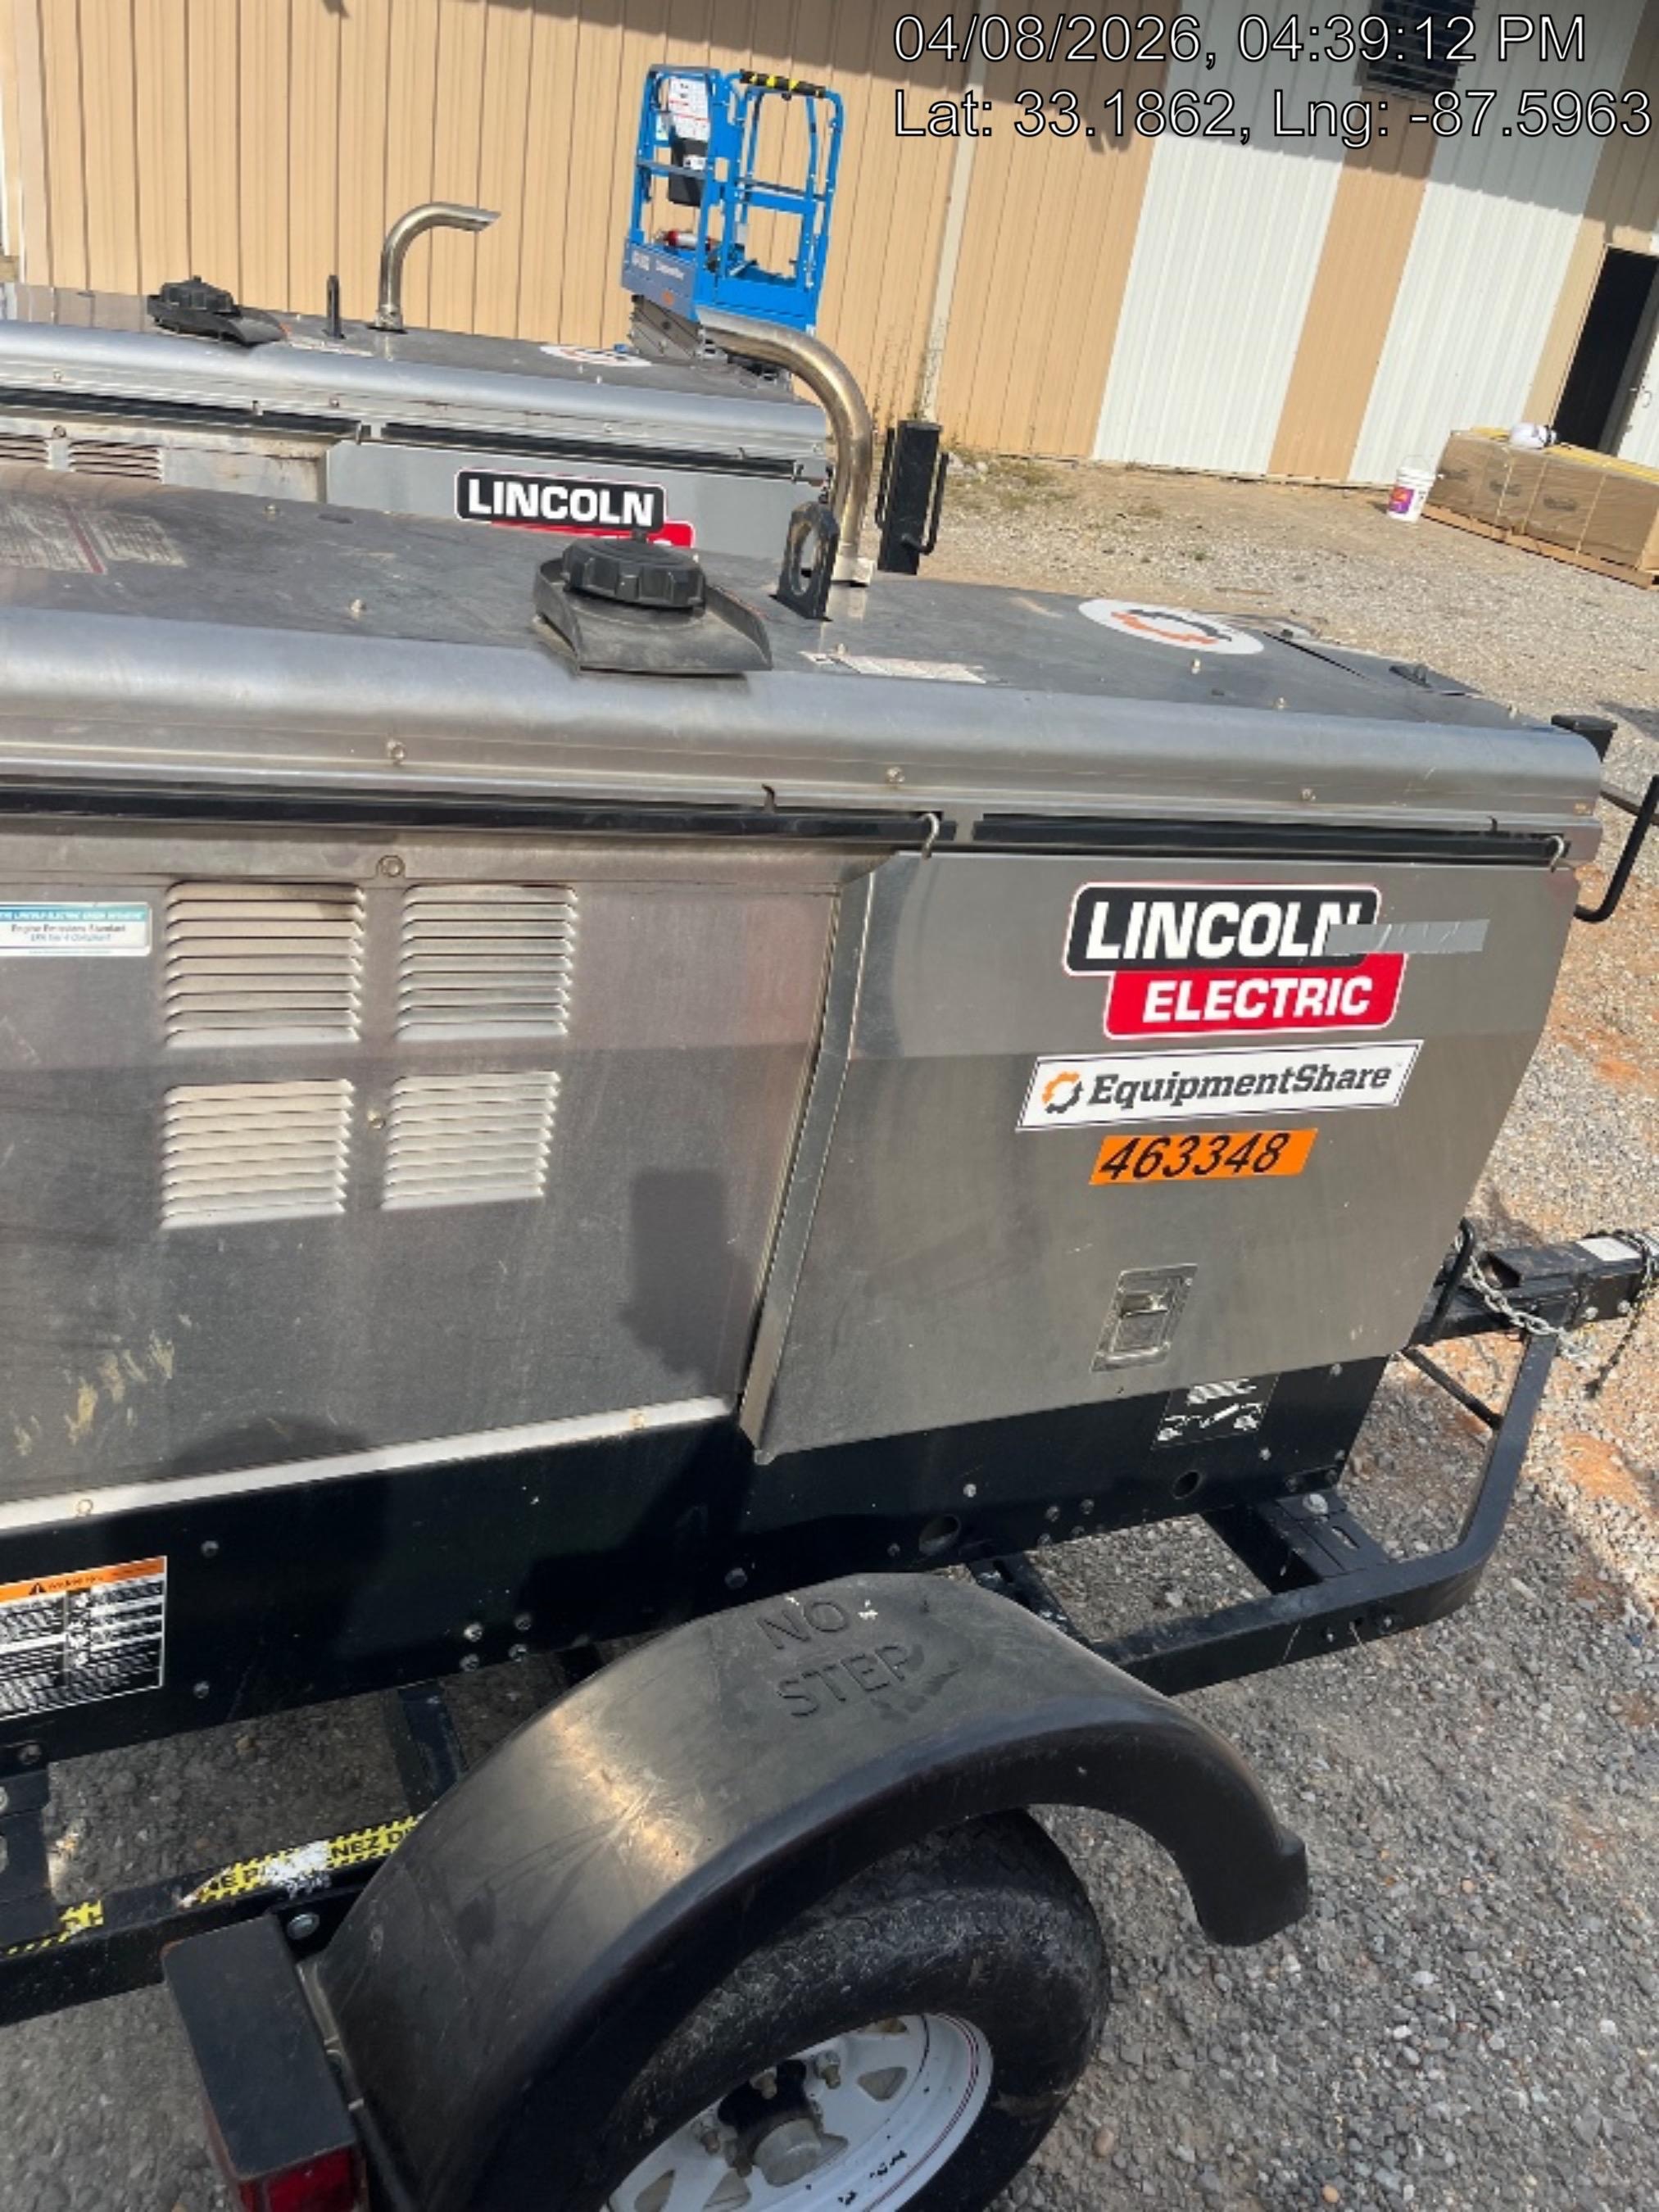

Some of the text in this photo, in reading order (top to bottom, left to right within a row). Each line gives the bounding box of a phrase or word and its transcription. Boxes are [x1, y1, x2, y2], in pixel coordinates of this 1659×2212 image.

[468, 478, 655, 527] LINCOLN
[1143, 977, 1373, 1023] ELECTRIC
[1086, 1063, 1391, 1109] EquipmentShare
[1099, 1132, 1290, 1181] 463348
[757, 1600, 849, 1650] NO
[776, 1644, 909, 1717] STEP
